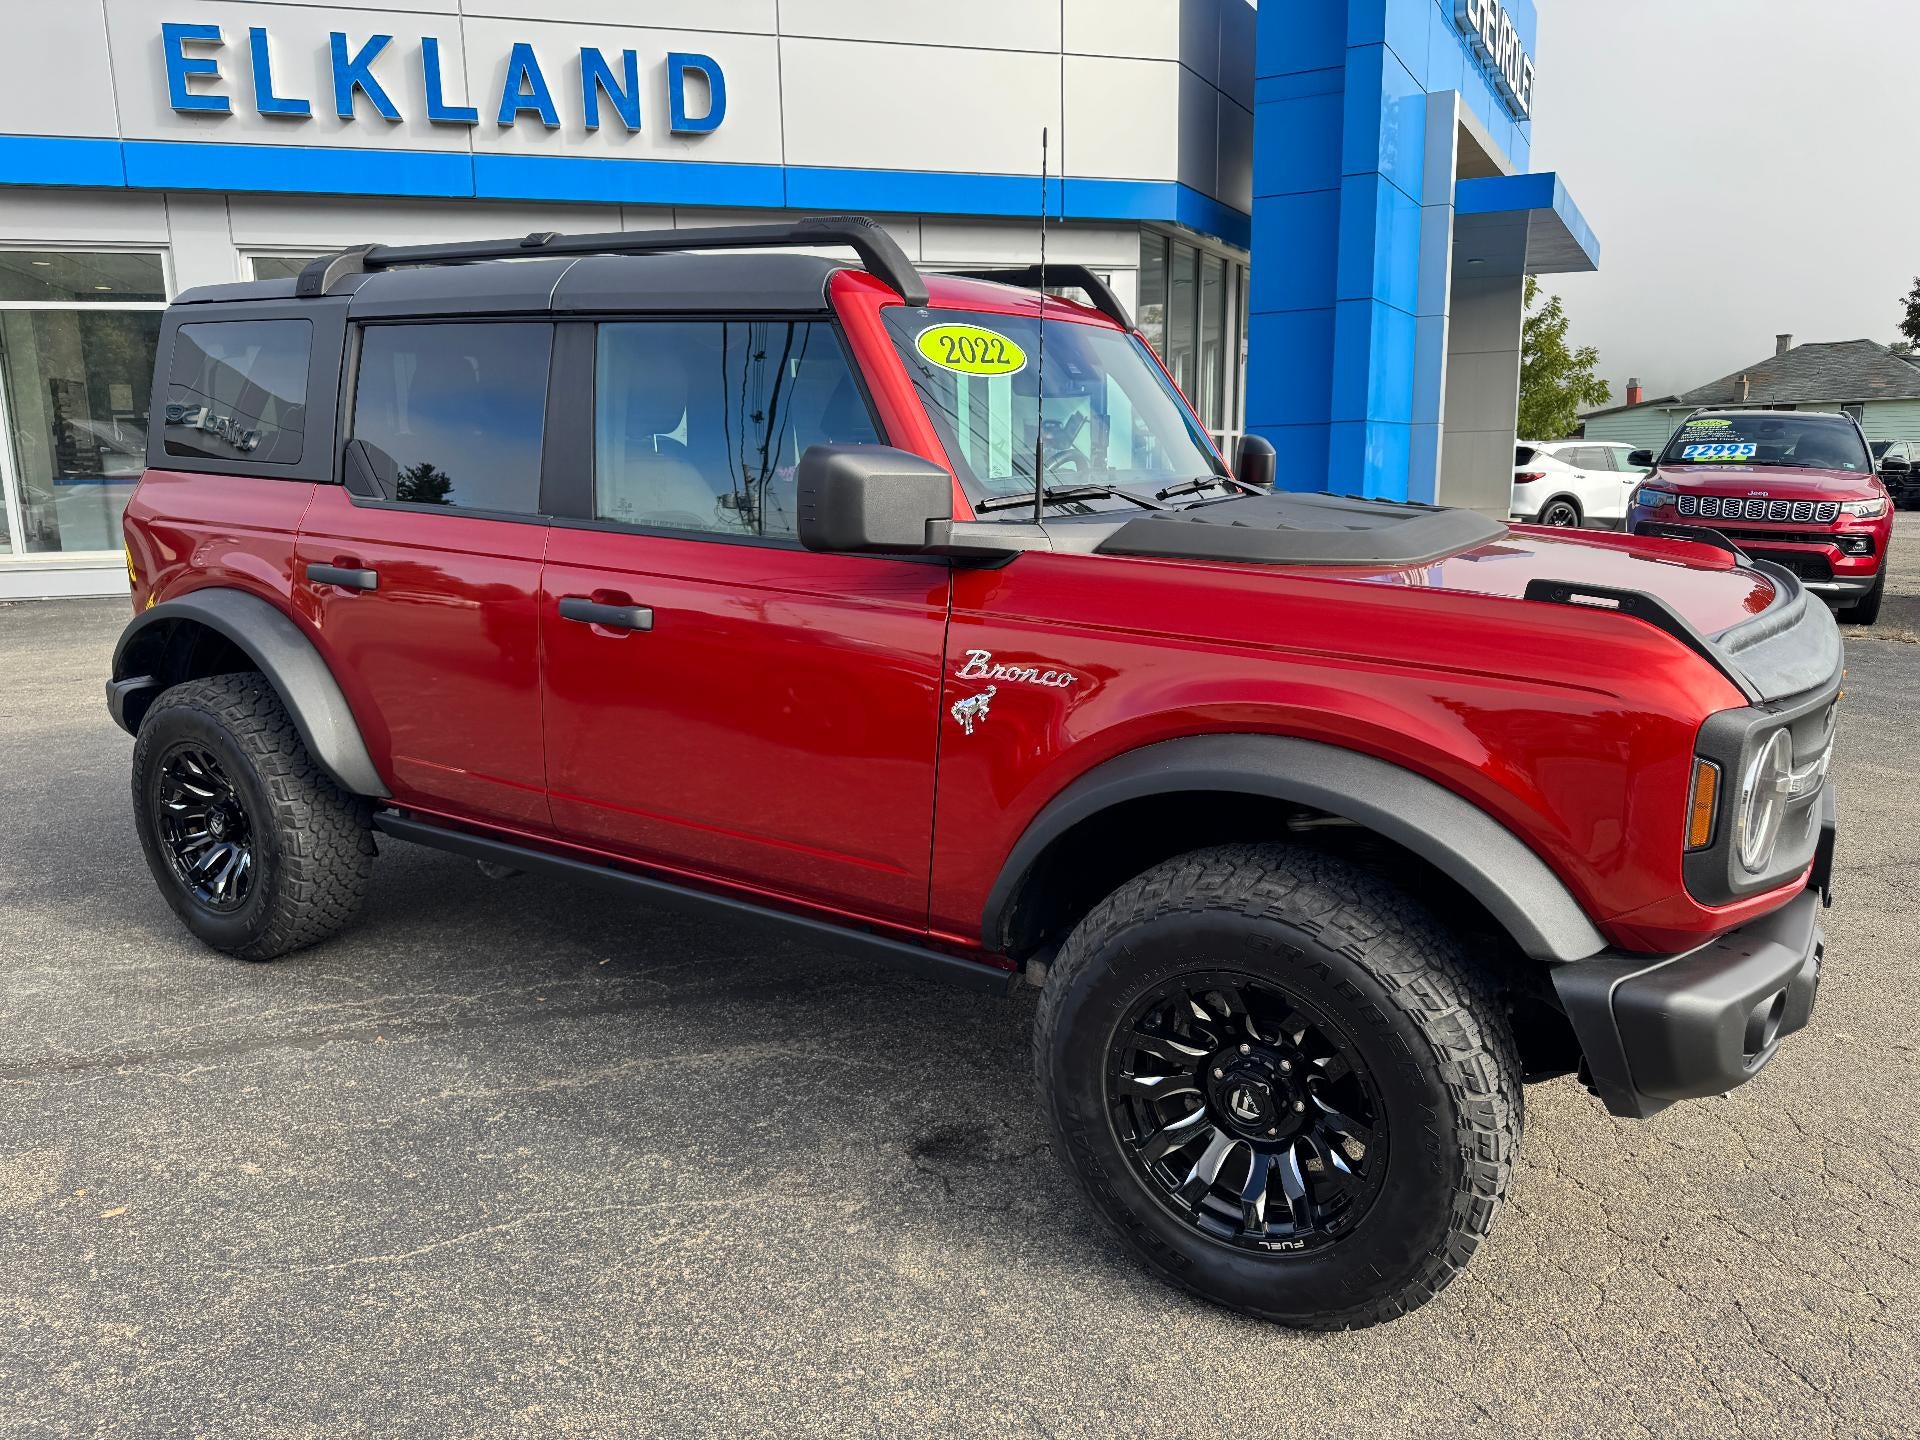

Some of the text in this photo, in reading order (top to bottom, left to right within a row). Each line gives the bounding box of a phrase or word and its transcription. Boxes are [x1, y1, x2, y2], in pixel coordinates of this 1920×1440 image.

[161, 23, 727, 135] ELKLAND
[939, 335, 1010, 365] 2022
[1683, 443, 1755, 458] 22995
[954, 649, 1078, 688] Bronco
[1258, 1239, 1305, 1250] FUEL
